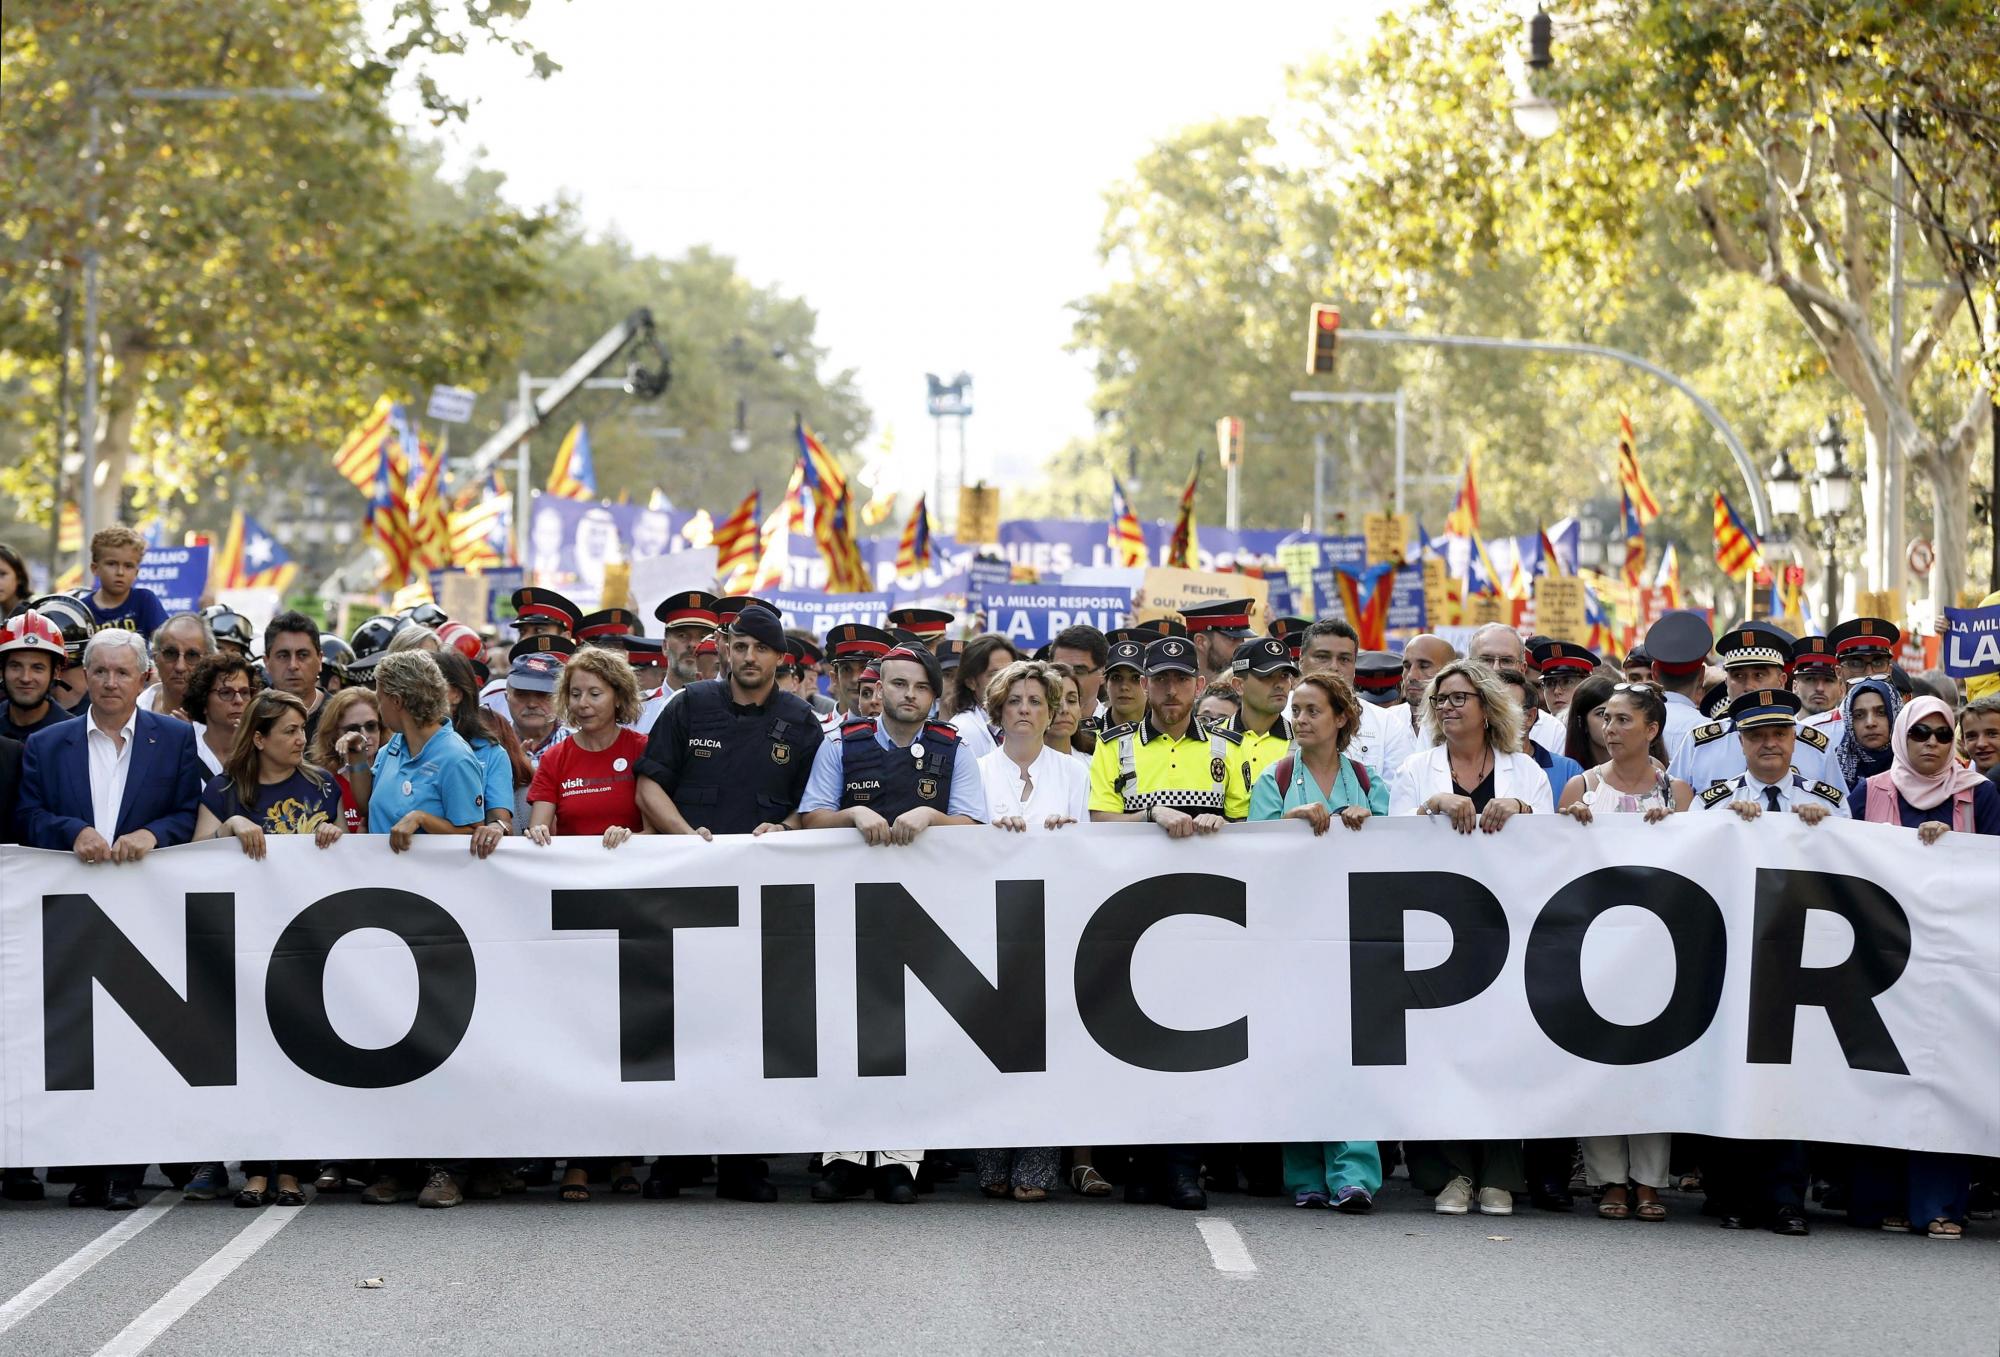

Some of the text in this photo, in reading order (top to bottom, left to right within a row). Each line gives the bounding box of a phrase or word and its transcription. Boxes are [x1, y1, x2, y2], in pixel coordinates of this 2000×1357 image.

[137, 567, 178, 580] OLEM
[1182, 584, 1230, 598] FELIPE,
[775, 598, 888, 613] MILLOR RESPOSTA
[988, 595, 1125, 610] LA MILLOR RESPOSTA
[986, 610, 1035, 641] LA
[1952, 620, 1969, 634] LA
[1950, 634, 2000, 668] LA
[689, 739, 722, 749] POLICIA
[561, 777, 584, 790] visit
[846, 780, 880, 792] POLICIA
[562, 786, 612, 797] visitbarcelona.com
[345, 808, 358, 818] sit
[42, 864, 1912, 1091] NO TINC POR
